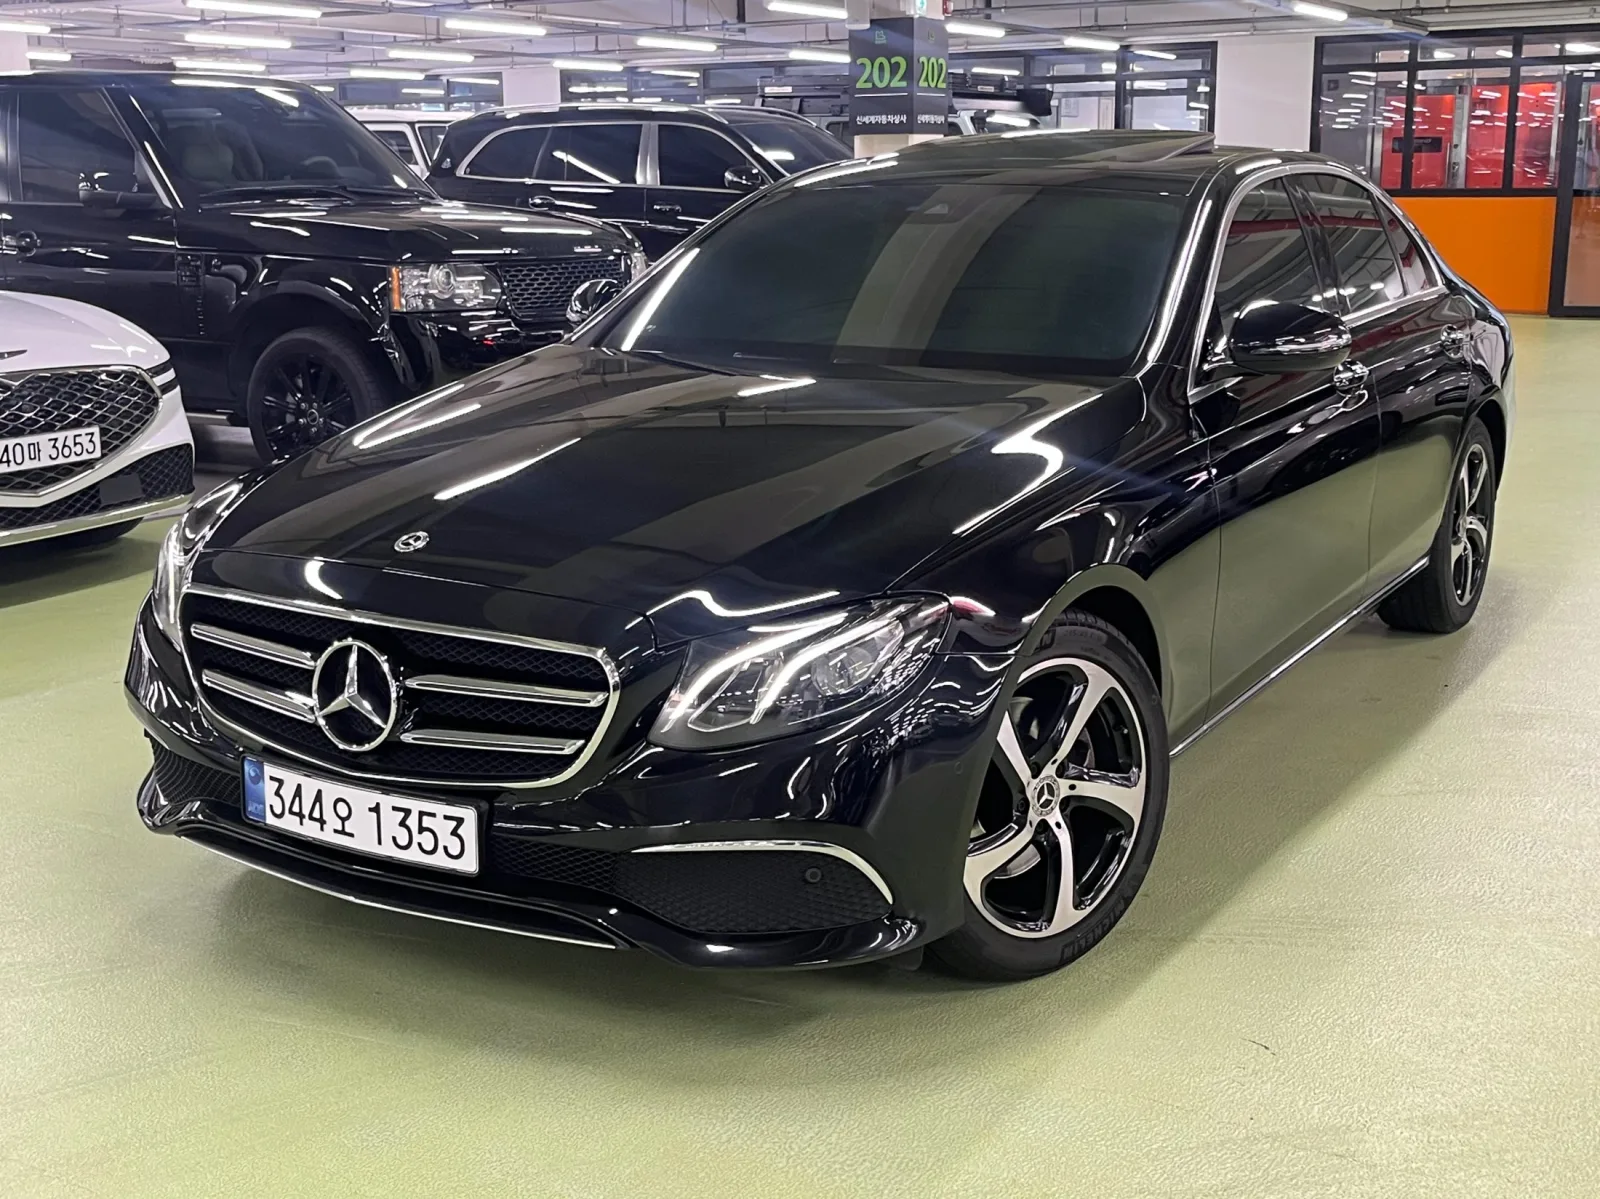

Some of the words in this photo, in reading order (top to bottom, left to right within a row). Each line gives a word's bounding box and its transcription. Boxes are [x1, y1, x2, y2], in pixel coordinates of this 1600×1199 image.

[855, 56, 907, 89] 202
[918, 56, 947, 89] 202
[0, 441, 41, 468] 40마
[48, 432, 96, 460] 3653
[269, 775, 355, 838] 344오
[368, 802, 466, 860] 1353
